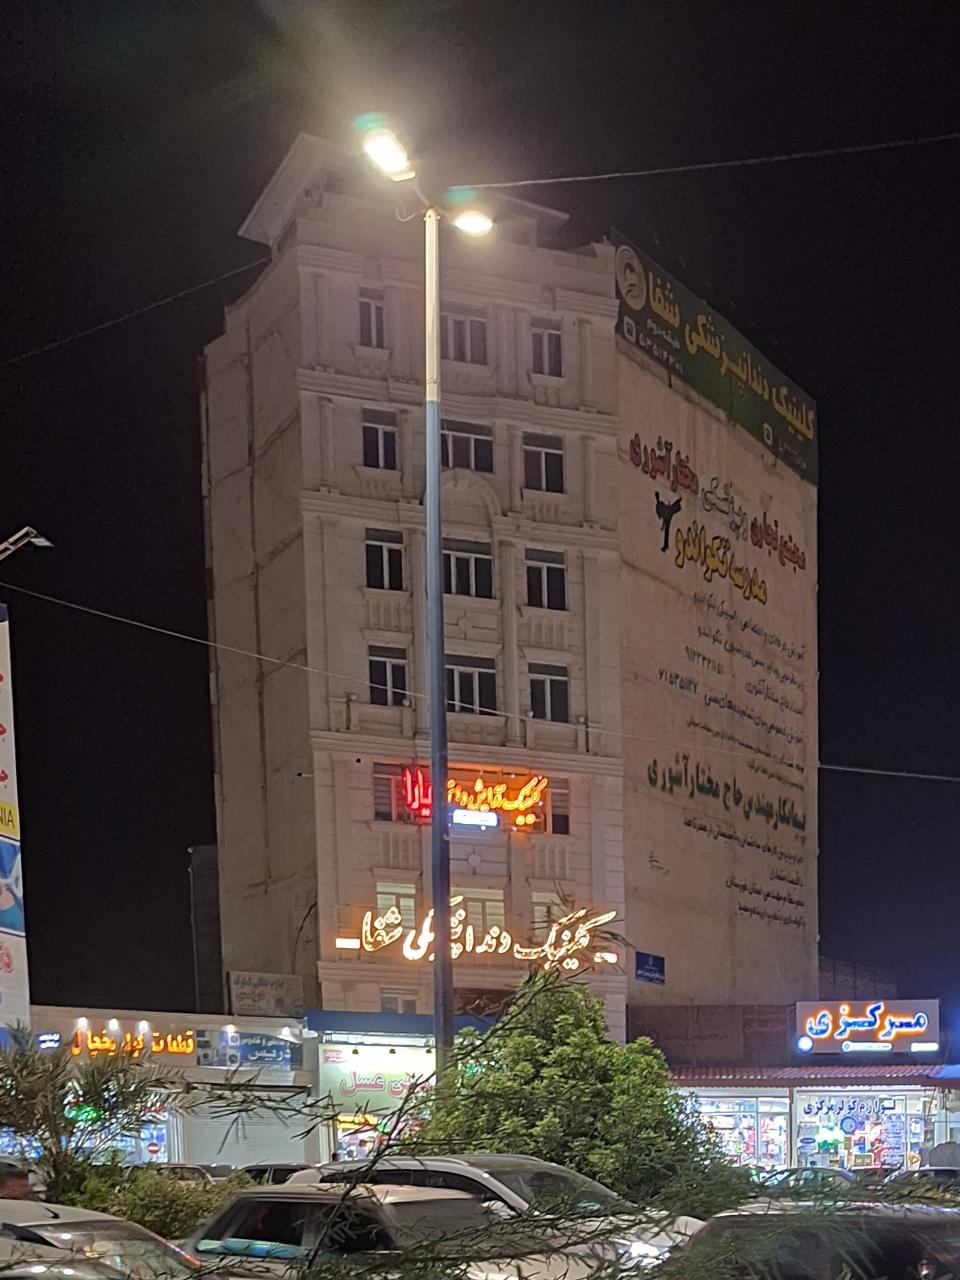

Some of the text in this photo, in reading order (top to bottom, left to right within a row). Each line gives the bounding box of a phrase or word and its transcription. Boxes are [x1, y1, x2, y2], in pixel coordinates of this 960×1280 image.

[648, 271, 681, 328] شفا
[362, 905, 402, 952] شفا
[806, 1002, 928, 1040] مرکزی
[151, 1030, 195, 1054] قطعات
[340, 1071, 386, 1097] عسل
[803, 1099, 835, 1115] مرکزی
[858, 1099, 897, 1115] لوازم
